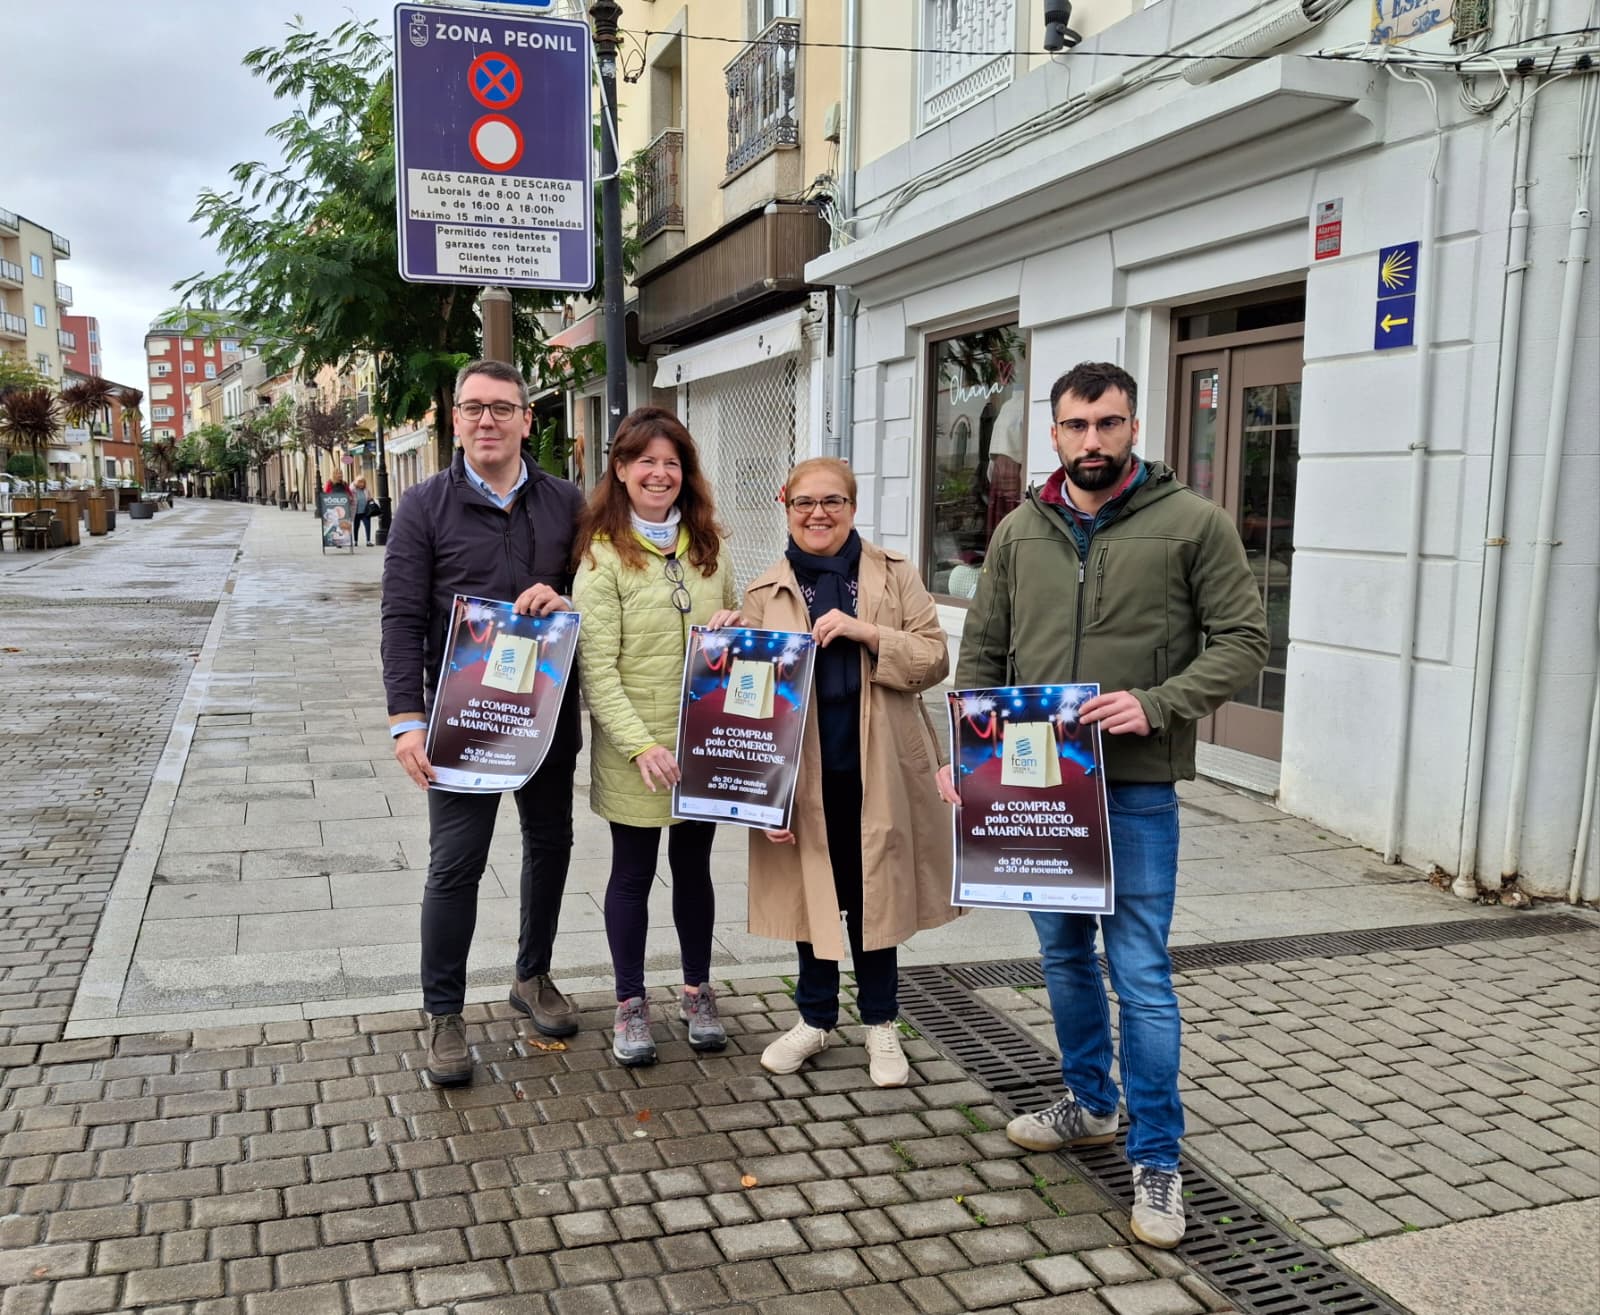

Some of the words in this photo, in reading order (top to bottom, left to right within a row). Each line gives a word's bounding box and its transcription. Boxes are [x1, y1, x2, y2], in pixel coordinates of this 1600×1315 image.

[435, 23, 493, 44] ZONA
[504, 30, 577, 52] PEONIL
[457, 174, 495, 186] CARGA
[501, 178, 508, 187] E
[513, 179, 572, 191] DESCARGA
[478, 187, 490, 198] de
[496, 189, 520, 200] 8:00
[527, 192, 534, 201] A
[540, 193, 565, 203] 11:00
[453, 199, 465, 209] de
[472, 201, 500, 211] 16:00
[506, 204, 513, 212] A
[520, 204, 554, 215] 18:00h
[457, 212, 468, 221] 15
[474, 213, 493, 223] min
[532, 217, 582, 229] Toneladas
[437, 226, 487, 238] Permitido
[493, 230, 546, 241] residentes
[445, 240, 485, 250] garaxes
[492, 243, 510, 251] con
[516, 243, 552, 254] tarxeta
[458, 252, 501, 263] Clientes
[504, 267, 515, 276] 15
[521, 268, 539, 277] min
[950, 366, 1004, 406] Ohana
[468, 697, 480, 707] de
[481, 700, 530, 716] COMPRAS
[460, 709, 480, 718] polo
[482, 711, 533, 727] COMERCIO
[446, 716, 459, 726] da
[460, 718, 499, 733] MARIÑA
[500, 724, 540, 738] LUCENSE
[712, 726, 724, 735] de
[726, 727, 773, 741] COMPRAS
[705, 738, 726, 747] polo
[727, 738, 777, 753] COMERCIO
[692, 746, 704, 756] da
[706, 747, 745, 760] MARIÑA
[746, 751, 785, 765] LUCENSE
[1011, 753, 1037, 767] fcam
[991, 801, 1005, 811] de
[1007, 801, 1066, 812] COMPRAS
[985, 813, 1009, 825] polo
[1011, 813, 1074, 825] COMERCIO
[971, 826, 985, 836] da
[987, 824, 1034, 837] MARIÑA
[1036, 826, 1090, 838] LUCENSE
[998, 857, 1009, 865] do
[1010, 857, 1021, 866] 20
[1023, 858, 1034, 866] de
[1035, 858, 1069, 867] outubro
[1019, 865, 1029, 874] de
[1031, 866, 1073, 875] novembro
